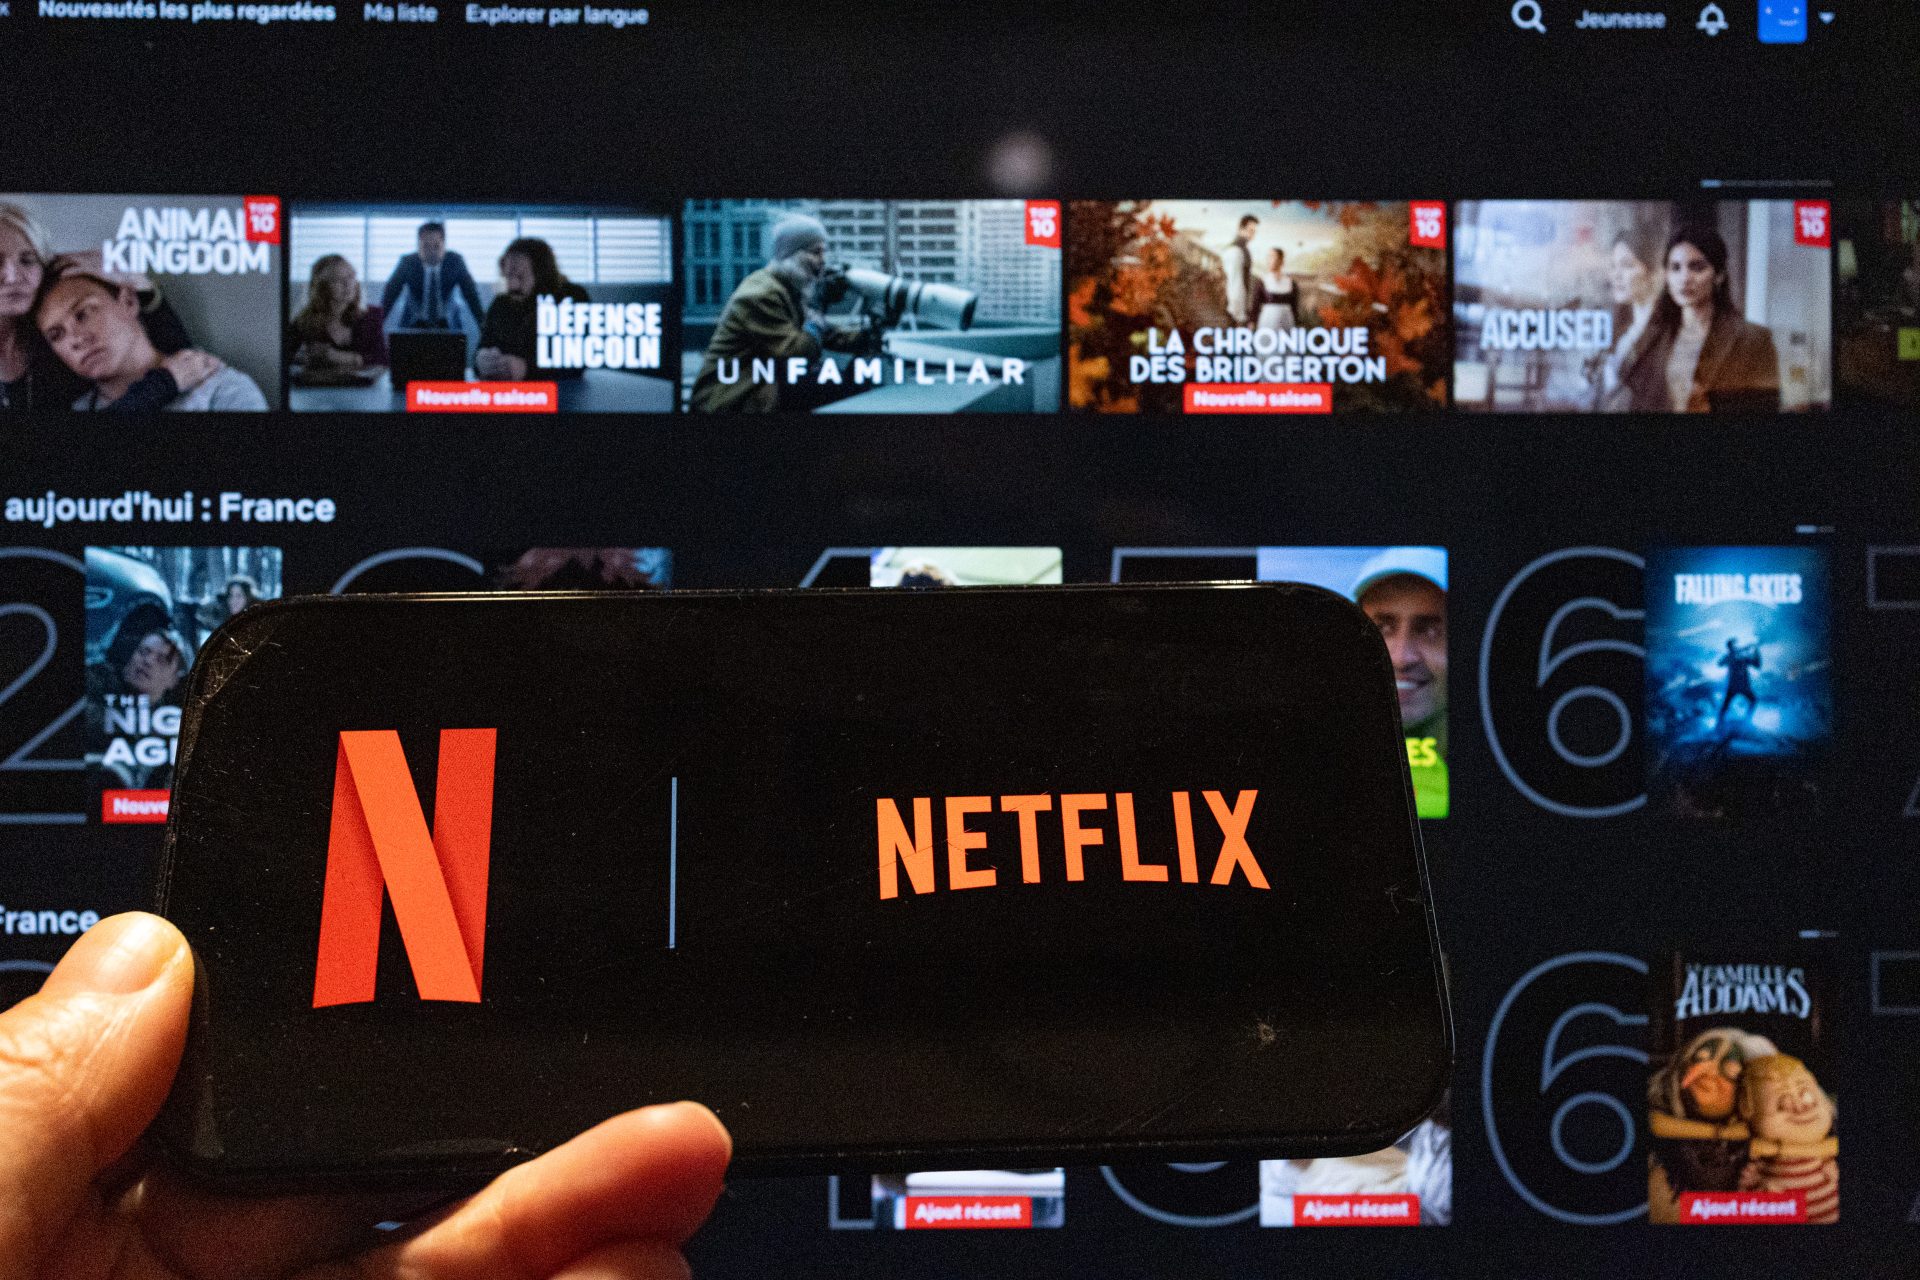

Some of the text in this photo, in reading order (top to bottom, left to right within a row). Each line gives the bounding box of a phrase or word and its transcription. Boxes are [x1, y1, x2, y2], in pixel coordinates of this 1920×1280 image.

[38, 0, 336, 24] Nouveautés les plus regardées
[363, 3, 438, 22] Ma liste
[465, 3, 650, 28] Explorer par langue
[1575, 9, 1667, 29] Jeunesse
[251, 215, 275, 233] 10
[1030, 219, 1056, 238] 10
[1415, 219, 1441, 239] 10
[1801, 219, 1826, 238] 10
[102, 240, 271, 275] KINGDOM
[536, 297, 662, 336] DÉFENSE
[1480, 309, 1613, 349] ACCUSED
[536, 335, 661, 369] LINCOLN
[1147, 326, 1369, 355] LA CHRONIQUE
[716, 357, 1026, 385] UNFAMILIAR
[1129, 355, 1386, 384] DES BRIDGERTON
[416, 388, 549, 406] Nouvelle saison
[1193, 390, 1323, 407] Nouvelle saison
[4, 491, 194, 528] aujourd'hui
[219, 492, 337, 522] France
[1749, 573, 1803, 605] SKIES
[1479, 545, 1647, 818] 6
[103, 705, 182, 735] NIG
[102, 737, 178, 766] AG
[1405, 736, 1438, 767] ES
[113, 798, 170, 815] Nouve
[876, 789, 1272, 901] NETFLIX
[1674, 968, 1811, 1020] ADDAMS
[914, 1203, 1022, 1224] Ajout récent
[1302, 1200, 1409, 1221] Ajout récent
[1690, 1199, 1797, 1220] Ajout récent
